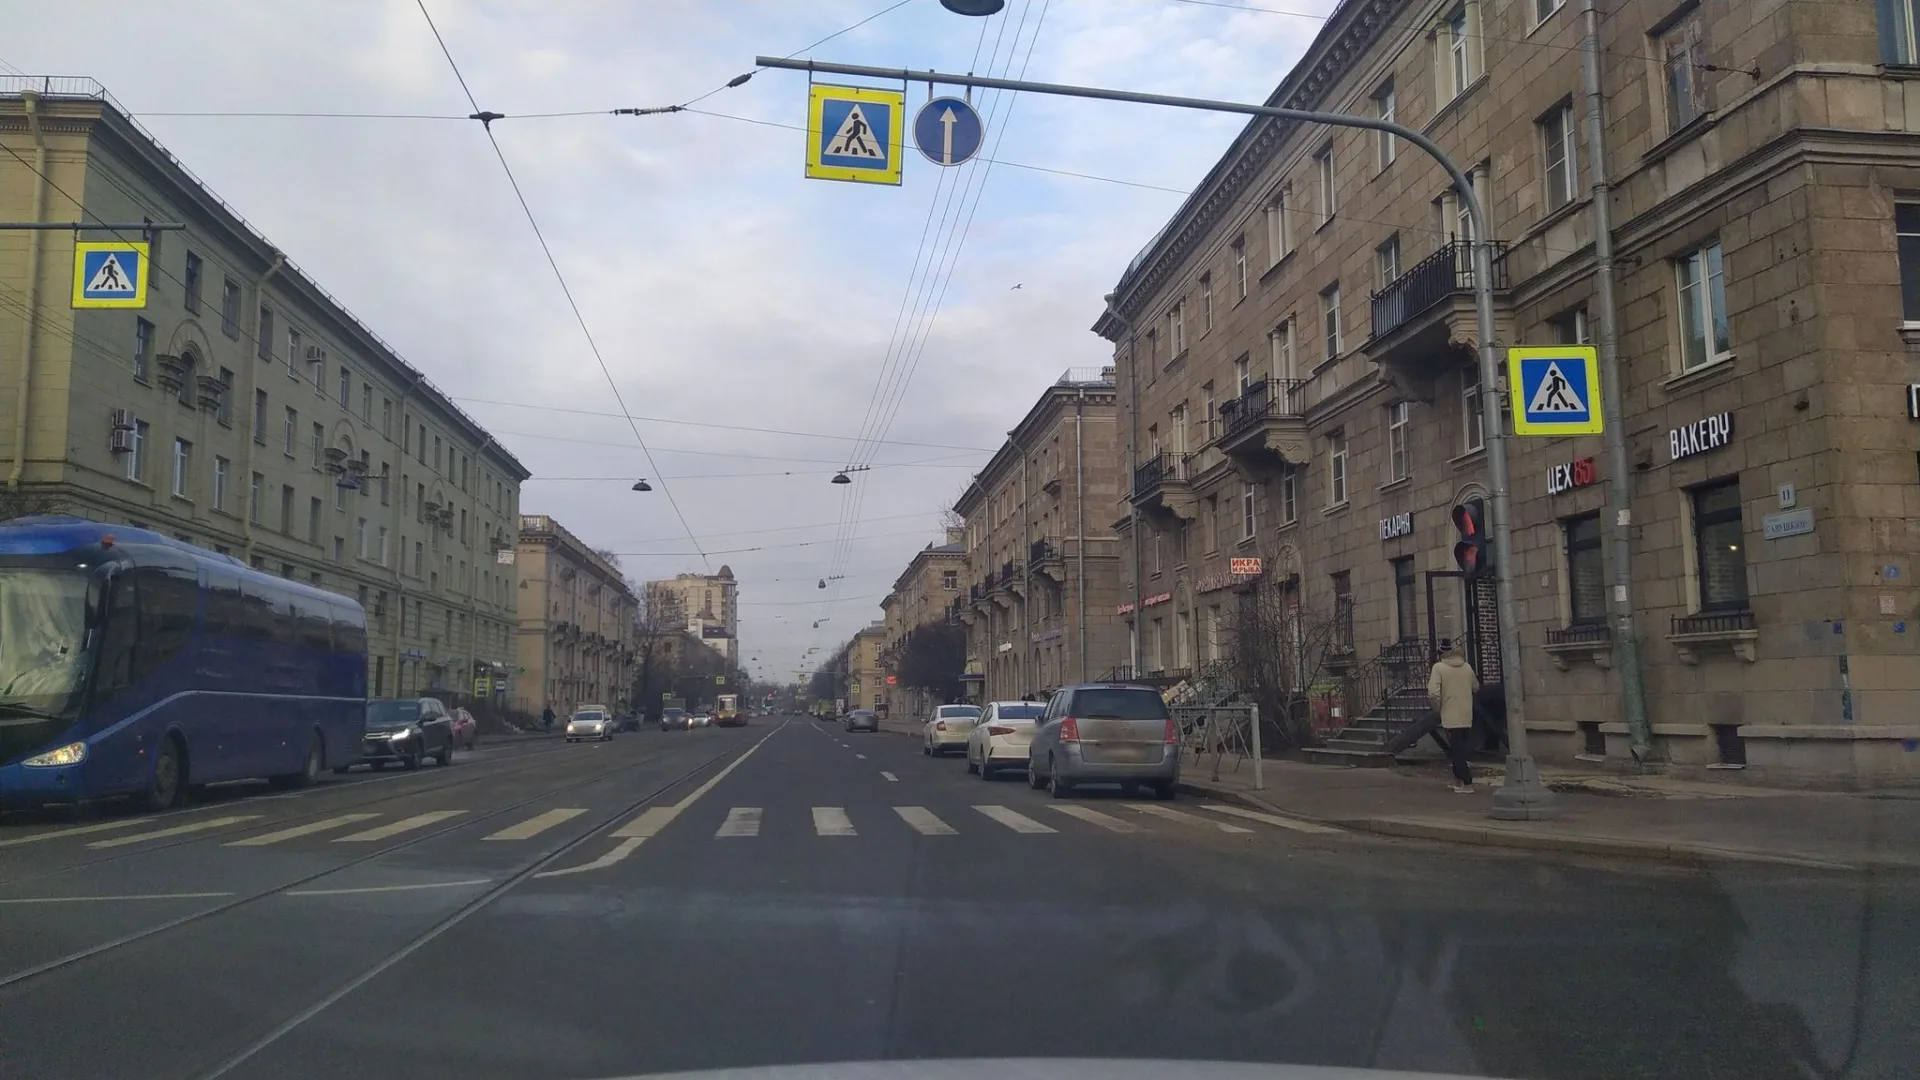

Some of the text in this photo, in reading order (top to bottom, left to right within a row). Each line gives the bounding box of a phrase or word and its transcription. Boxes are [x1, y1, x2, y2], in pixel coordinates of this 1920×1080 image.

[1670, 411, 1730, 460] BAKERY
[1782, 489, 1790, 500] 11
[1379, 512, 1411, 541] ПЕКАРНЯ
[1232, 559, 1260, 567] ИКРА
